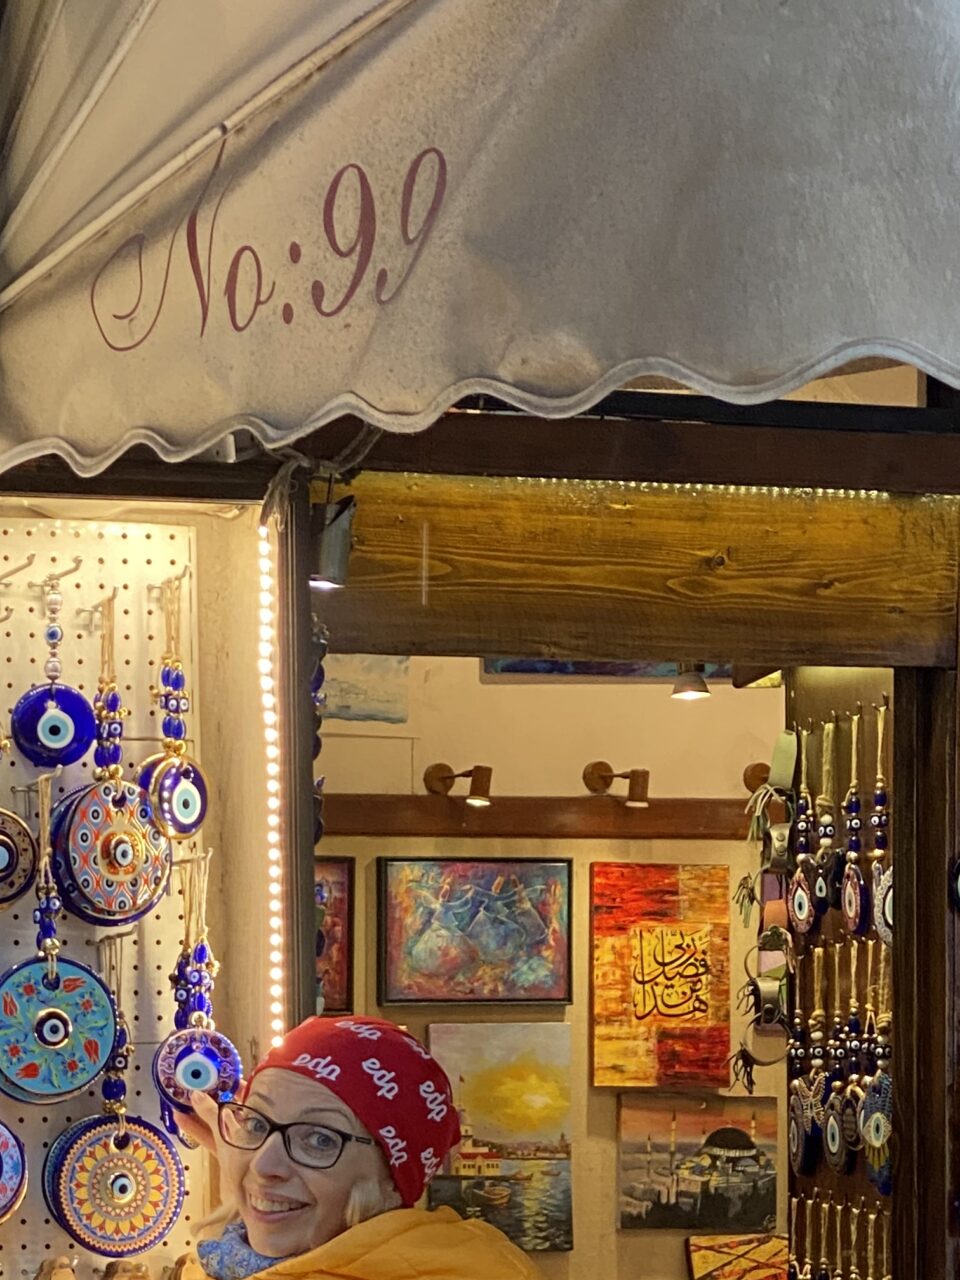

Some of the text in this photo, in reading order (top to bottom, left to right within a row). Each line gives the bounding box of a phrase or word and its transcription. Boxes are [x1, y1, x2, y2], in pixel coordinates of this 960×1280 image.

[91, 133, 447, 352] No:99
[335, 1020, 383, 1041] edp
[292, 1053, 341, 1081] edp
[361, 1057, 400, 1100] edp
[419, 1080, 448, 1122] edp
[378, 1125, 408, 1168] edp
